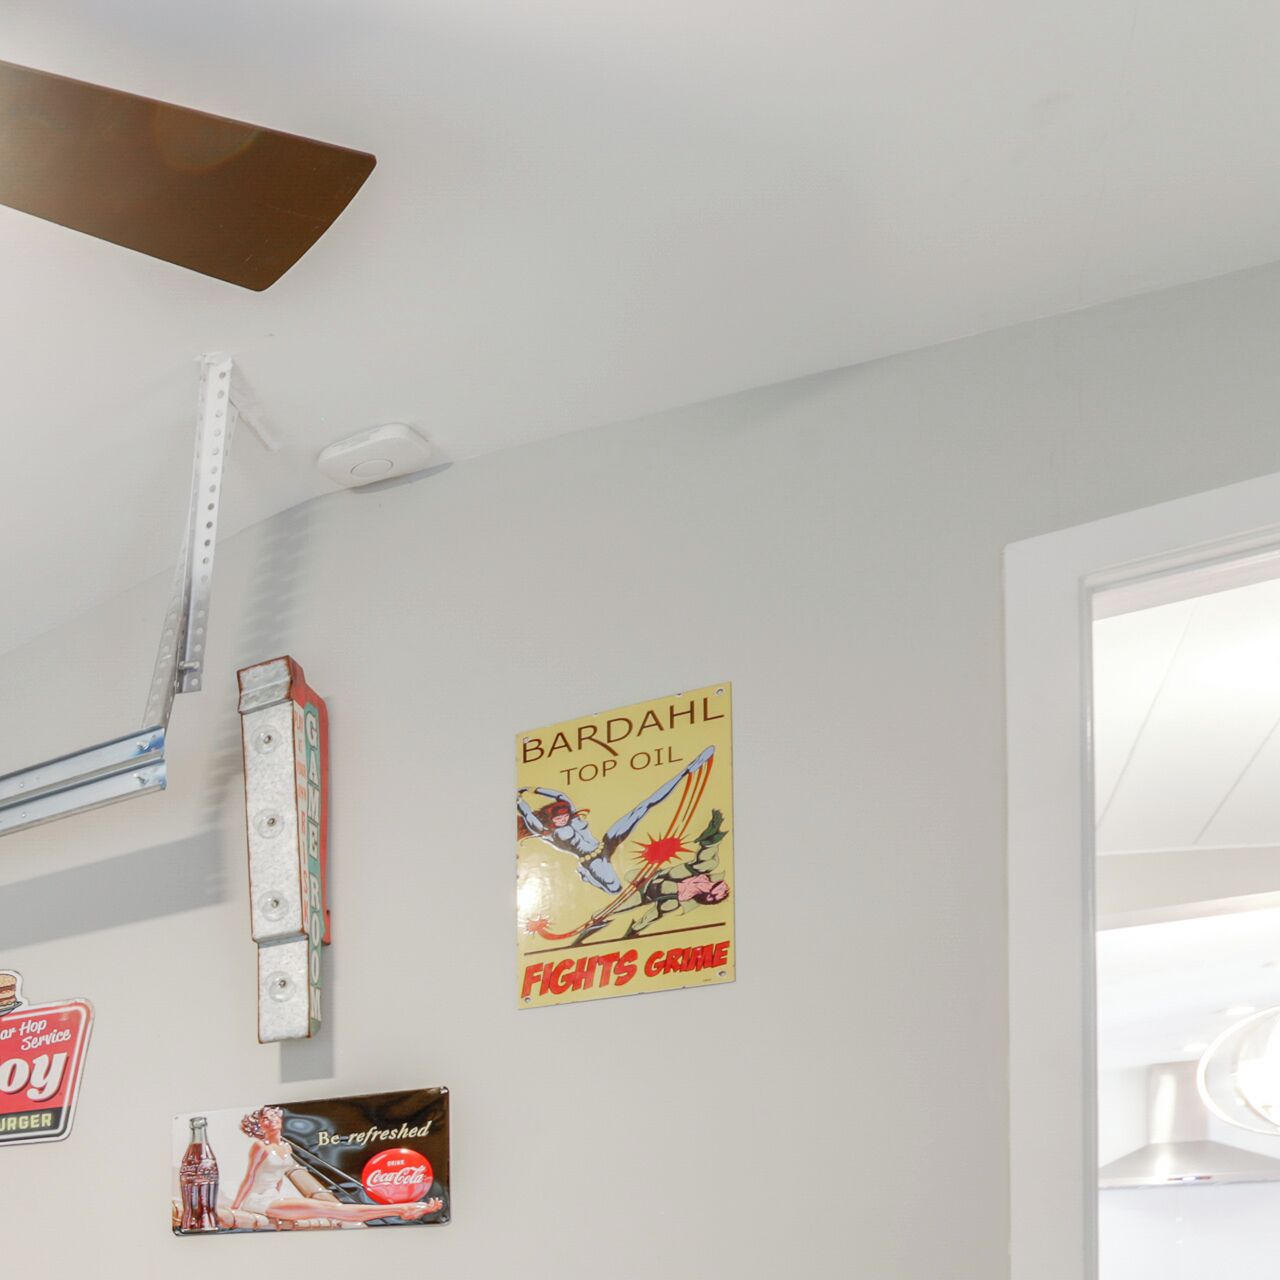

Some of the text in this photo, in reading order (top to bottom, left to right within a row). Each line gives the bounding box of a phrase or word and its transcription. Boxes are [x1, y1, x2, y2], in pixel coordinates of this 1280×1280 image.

[522, 697, 725, 764] BARDAHL
[560, 746, 683, 786] TOP OIL
[305, 711, 321, 1021] GAME ROOM
[521, 940, 730, 998] FIGHTS GRIME
[18, 1019, 47, 1036] Hop
[21, 1029, 72, 1051] Service
[318, 1120, 433, 1147] Be refreshed
[366, 1165, 427, 1187] Coca-Cola
